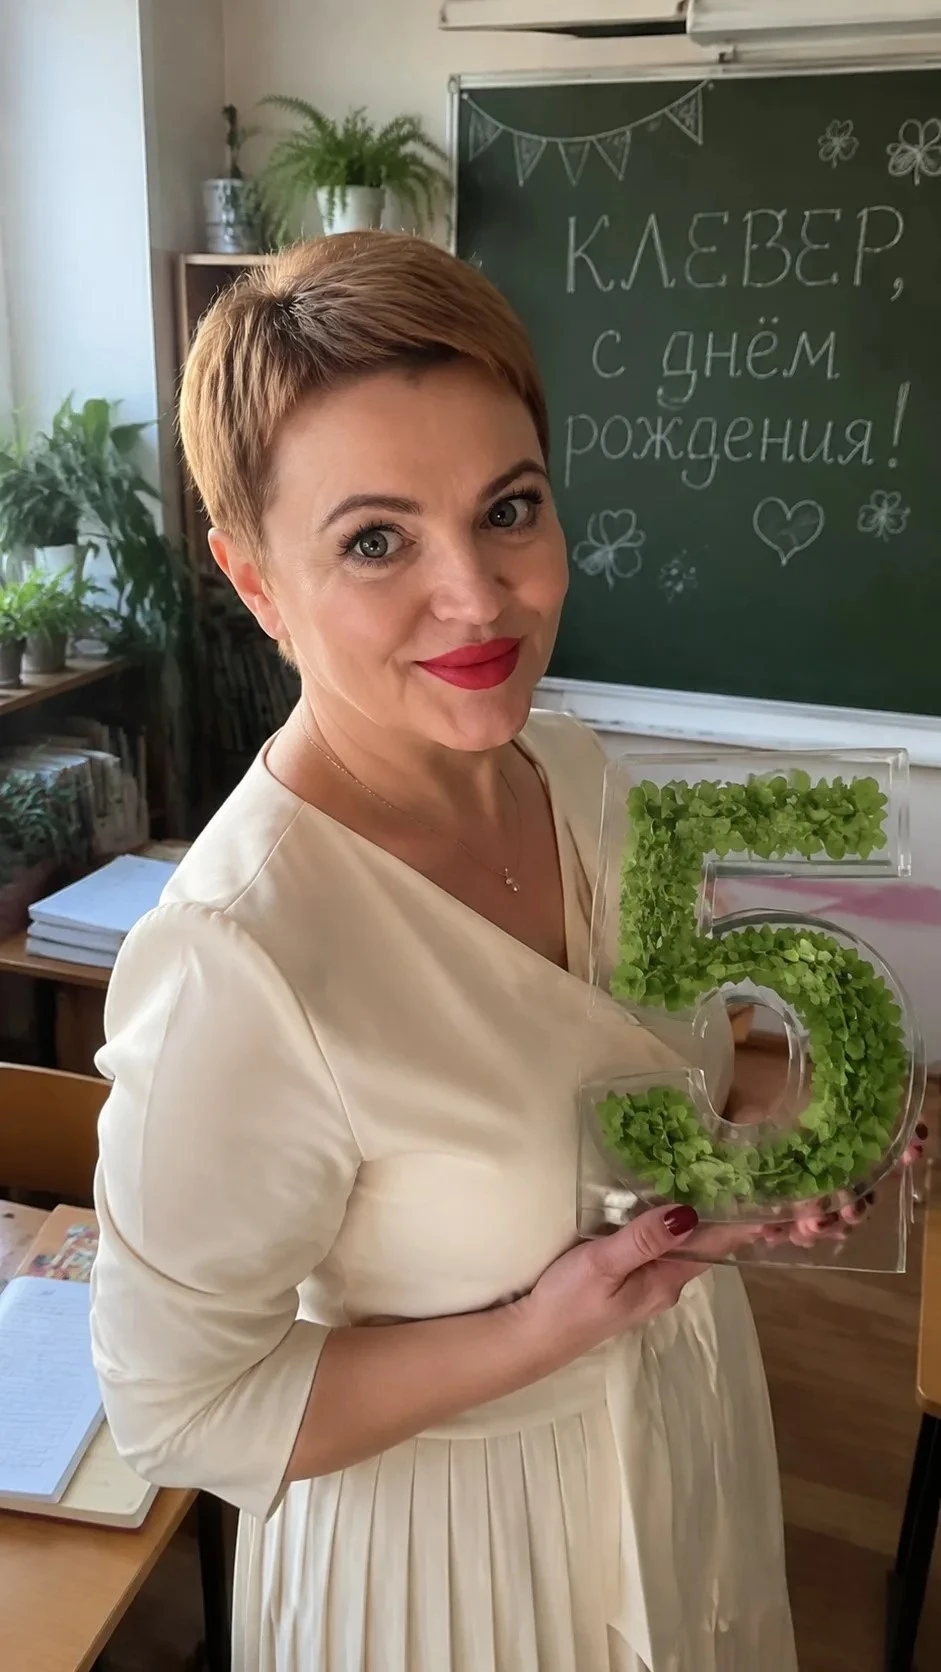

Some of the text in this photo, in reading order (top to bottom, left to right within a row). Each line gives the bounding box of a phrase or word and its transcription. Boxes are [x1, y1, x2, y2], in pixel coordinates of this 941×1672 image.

[566, 205, 906, 301] КЛЕВЕР,
[656, 316, 841, 407] днём
[563, 380, 911, 490] рождения!
[588, 755, 918, 1222] 5
